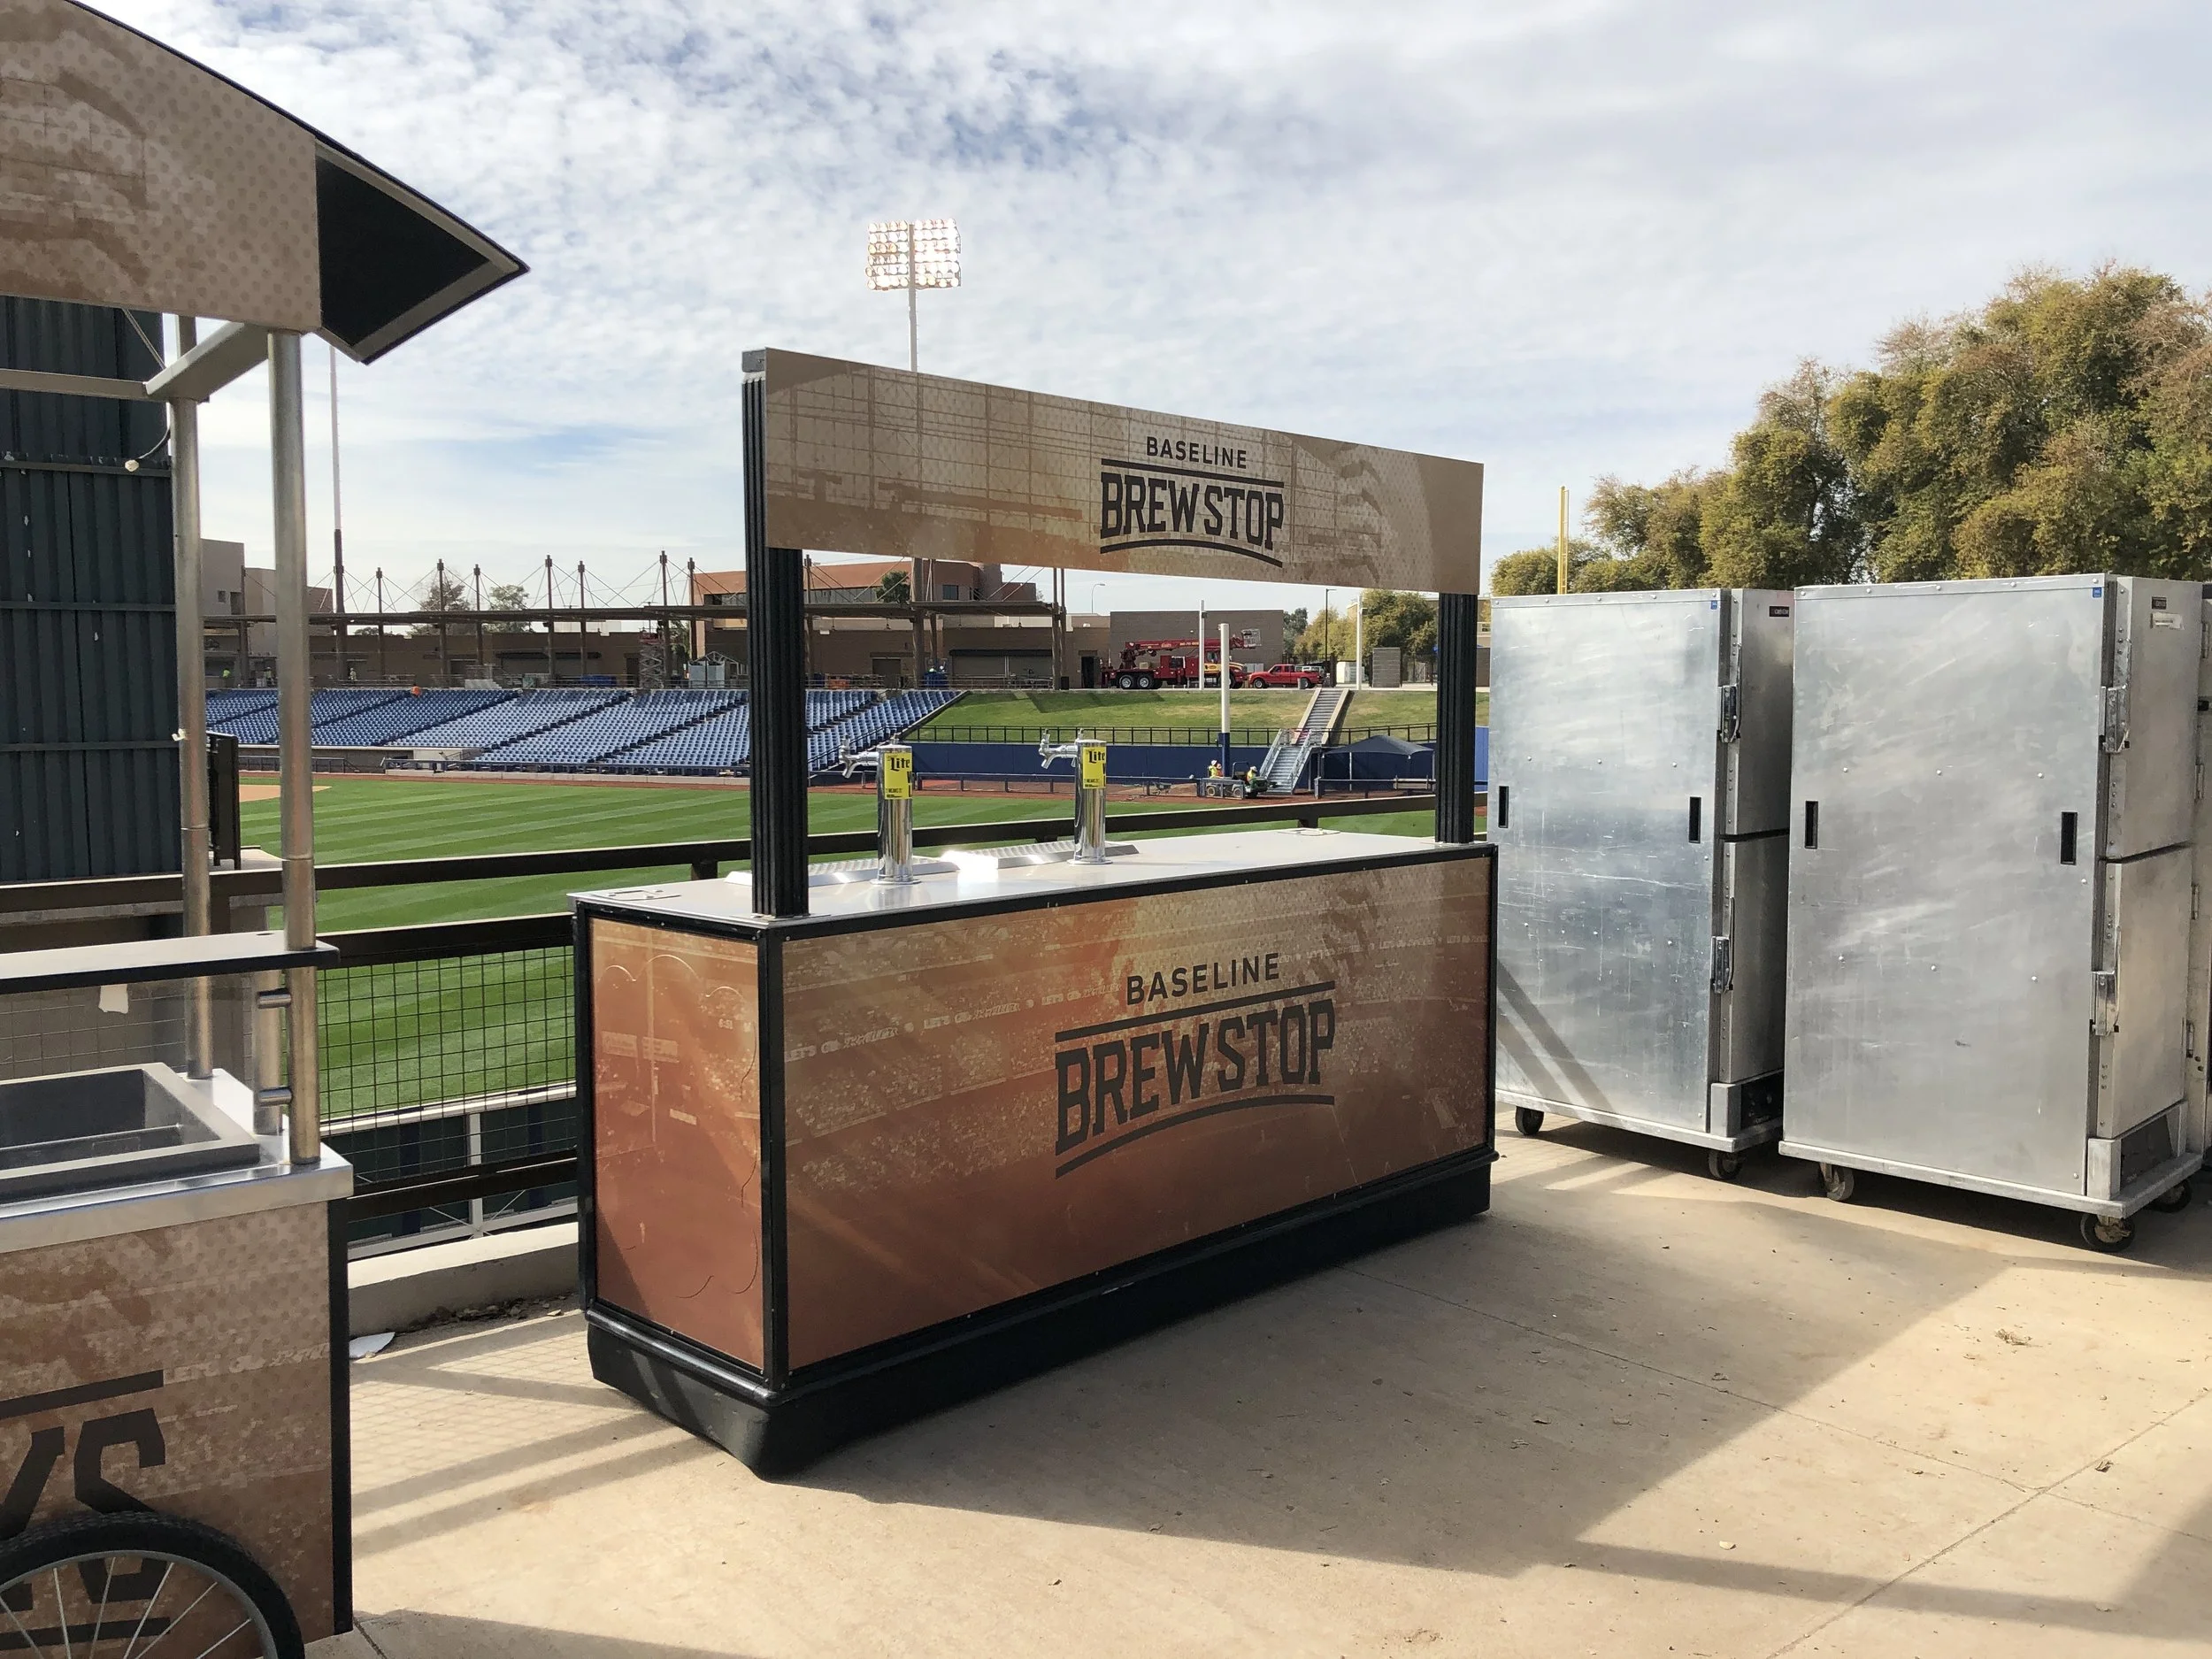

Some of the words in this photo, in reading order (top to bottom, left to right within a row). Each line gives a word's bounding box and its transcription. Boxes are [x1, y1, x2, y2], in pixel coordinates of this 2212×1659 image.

[1147, 437, 1247, 470] BASELINE
[890, 757, 910, 772] Lite
[1087, 750, 1106, 764] Lite
[1126, 952, 1279, 1006] BASELINE
